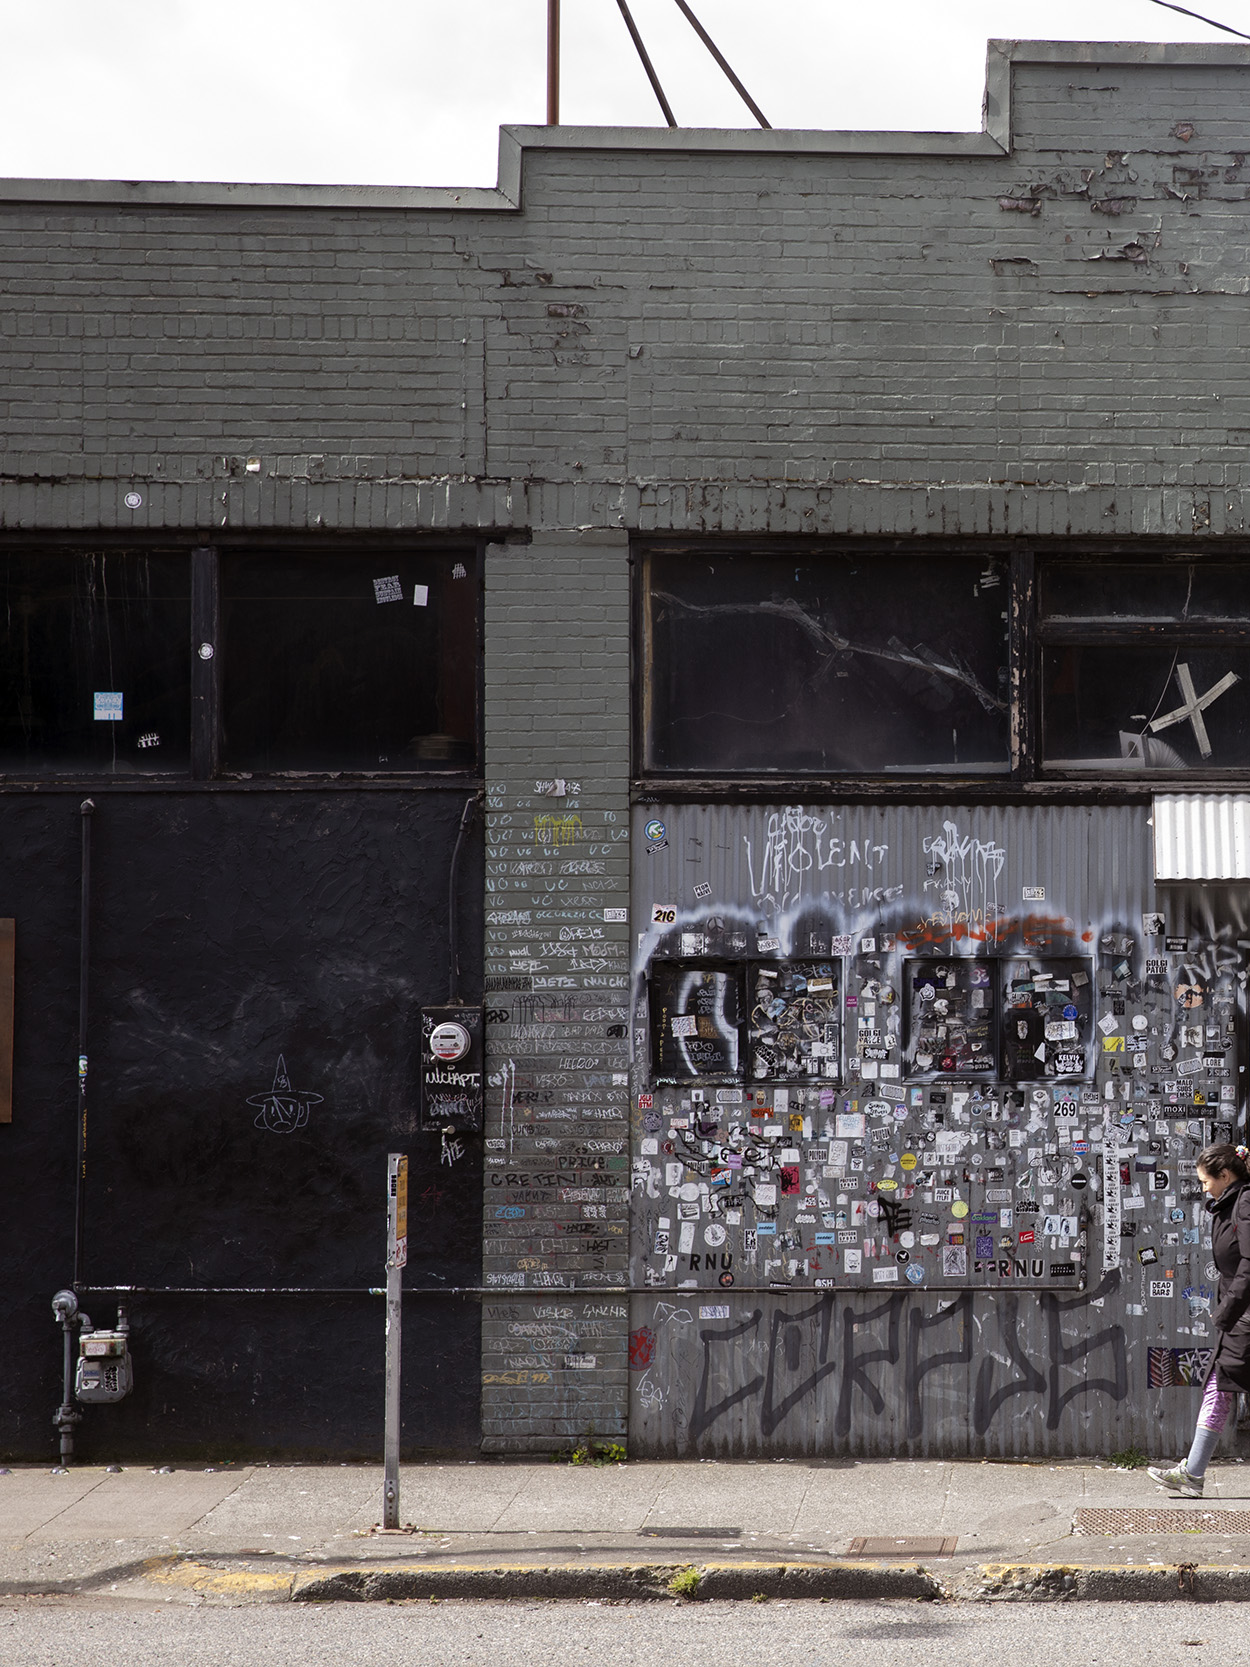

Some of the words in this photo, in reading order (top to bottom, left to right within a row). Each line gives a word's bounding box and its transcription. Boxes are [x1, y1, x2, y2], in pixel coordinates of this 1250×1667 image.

[536, 976, 577, 988] YETI
[850, 1058, 857, 1068] 2
[1206, 1058, 1222, 1066] LORE
[1054, 1102, 1076, 1116] 269
[872, 1127, 891, 1141] POLYGON
[809, 1150, 827, 1160] POLYGON
[492, 1174, 576, 1186] CRETIN
[690, 1253, 732, 1271] RNU
[998, 1260, 1044, 1278] RNU
[1152, 1282, 1172, 1290] DEAD
[1152, 1289, 1170, 1297] BARS
